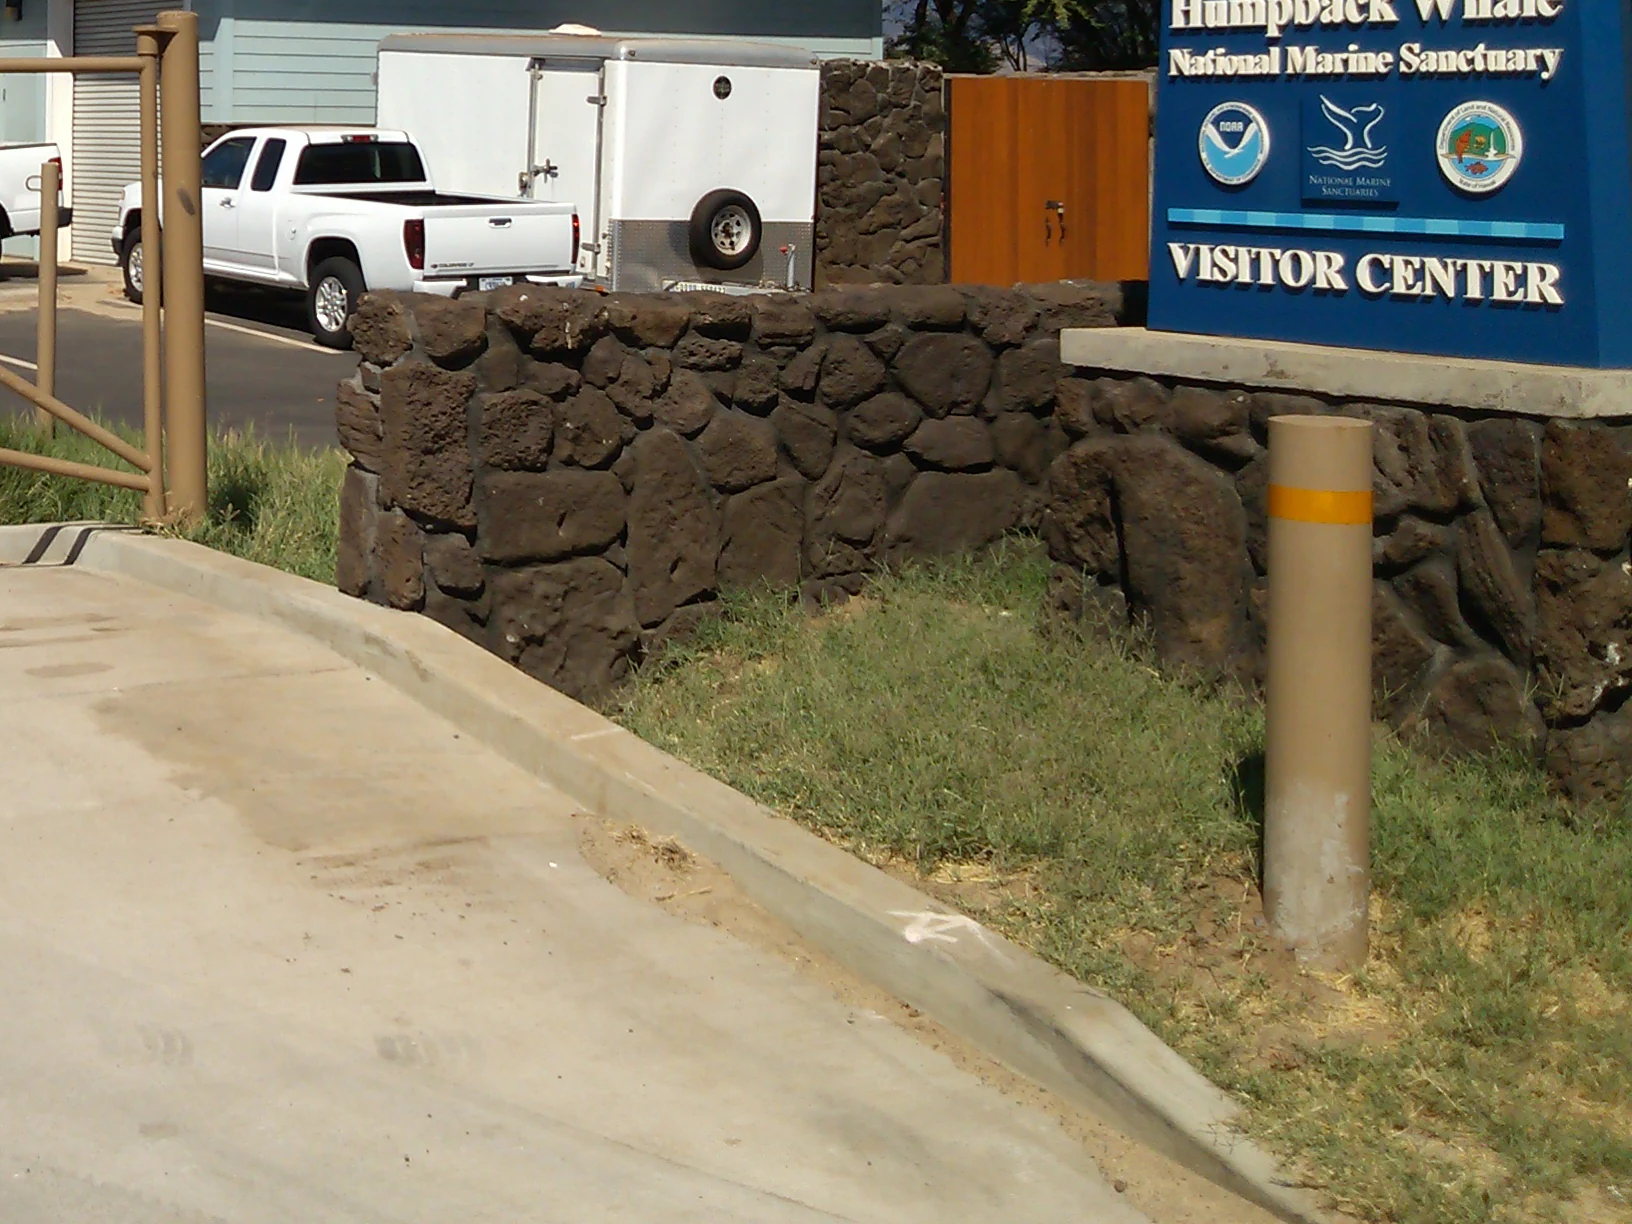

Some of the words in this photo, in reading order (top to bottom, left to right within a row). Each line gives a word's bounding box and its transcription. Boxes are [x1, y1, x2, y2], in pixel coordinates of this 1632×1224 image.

[1168, 46, 1281, 77] National
[1285, 43, 1394, 75] Marine
[1399, 42, 1565, 81] Sanctuary
[1309, 175, 1353, 186] NATIONAL
[1356, 177, 1391, 187] MARINE
[1321, 185, 1379, 197] SANCTUARIES
[1168, 242, 1349, 291] VISITOR
[1356, 252, 1565, 306] CENTER
